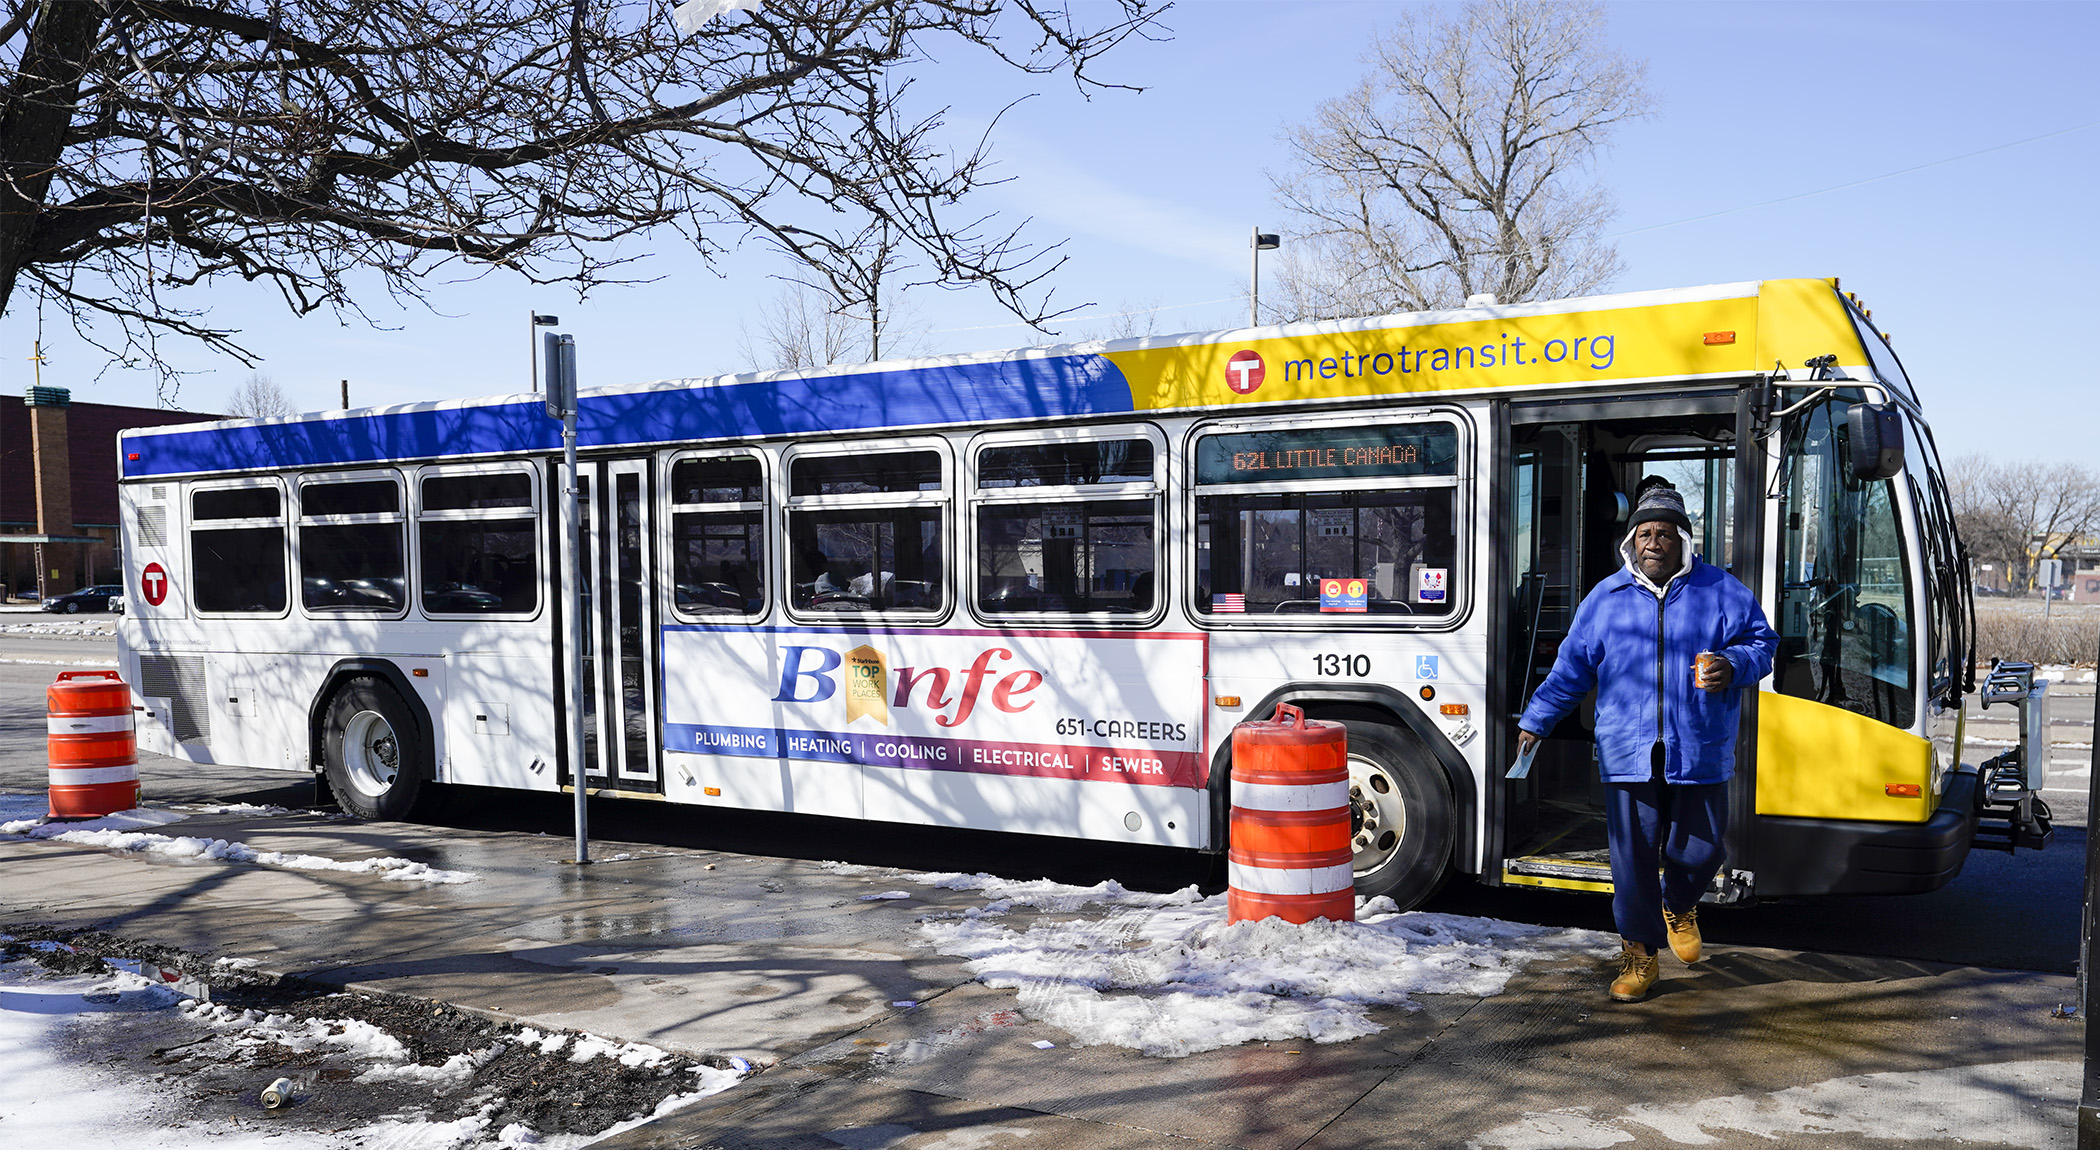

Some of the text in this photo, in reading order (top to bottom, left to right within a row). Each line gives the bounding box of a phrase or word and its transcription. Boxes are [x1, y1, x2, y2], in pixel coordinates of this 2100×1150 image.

[1284, 332, 1615, 382] metrotransit.org
[1233, 444, 1417, 471] 62L LITTLE CANADA
[852, 665, 880, 679] TOP
[1312, 653, 1371, 678] 1310
[852, 679, 880, 689] WORK
[852, 689, 881, 698] PLACES
[1055, 718, 1187, 742] 651-CAREERS
[695, 732, 1164, 775] PLUMBING HEATING COOLING ELECTRICAL SEWER
